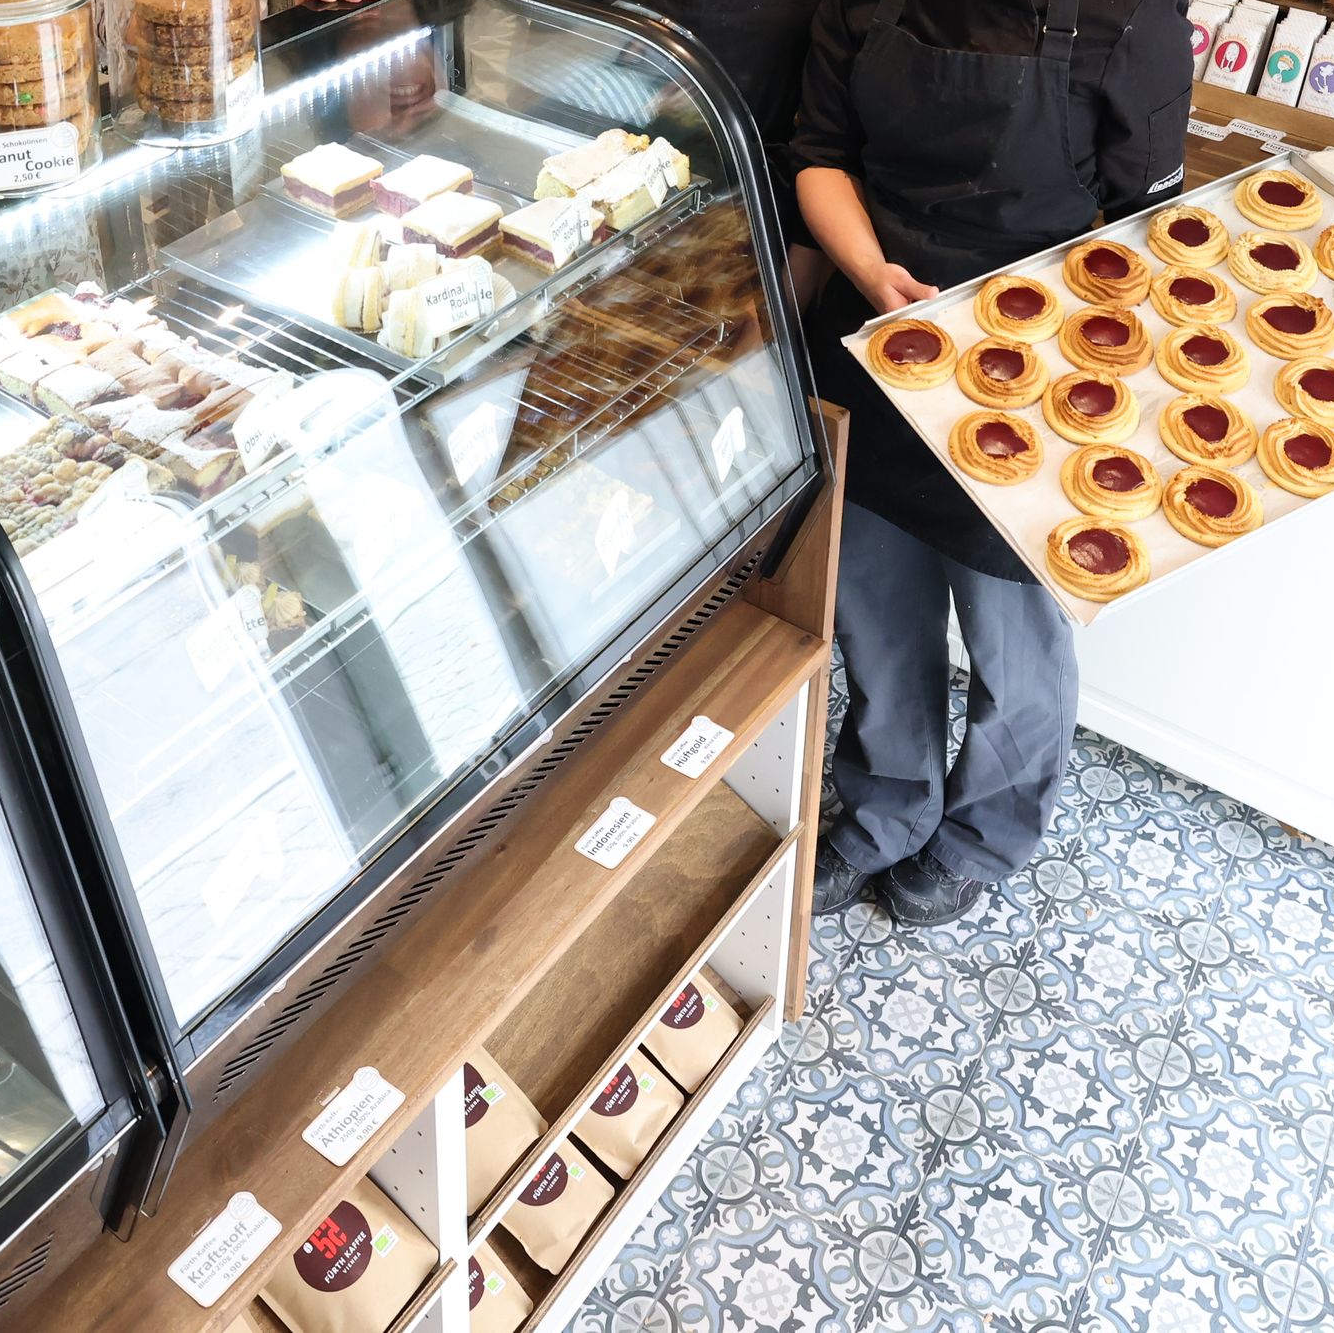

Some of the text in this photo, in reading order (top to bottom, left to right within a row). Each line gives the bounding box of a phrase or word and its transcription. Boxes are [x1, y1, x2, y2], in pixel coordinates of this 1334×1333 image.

[13, 172, 41, 184] 2,50 €
[25, 156, 74, 172] Cookie
[425, 282, 465, 307] Kardinal
[674, 735, 707, 768] Hüftgold
[587, 812, 631, 856] Indonesien
[369, 1088, 392, 1115] Arabica
[318, 1093, 375, 1149] Äthiopien
[355, 1124, 373, 1142] 9,90
[179, 1236, 217, 1275] Fürth Kaffee
[187, 1220, 247, 1285] Kraftstoff
[197, 1216, 269, 1290] Blend 250g 100% Arabica
[223, 1254, 249, 1281] 9,90 €
[323, 1230, 367, 1284] FÜRTH KAFFEE
[341, 1251, 361, 1274] VIENNA
